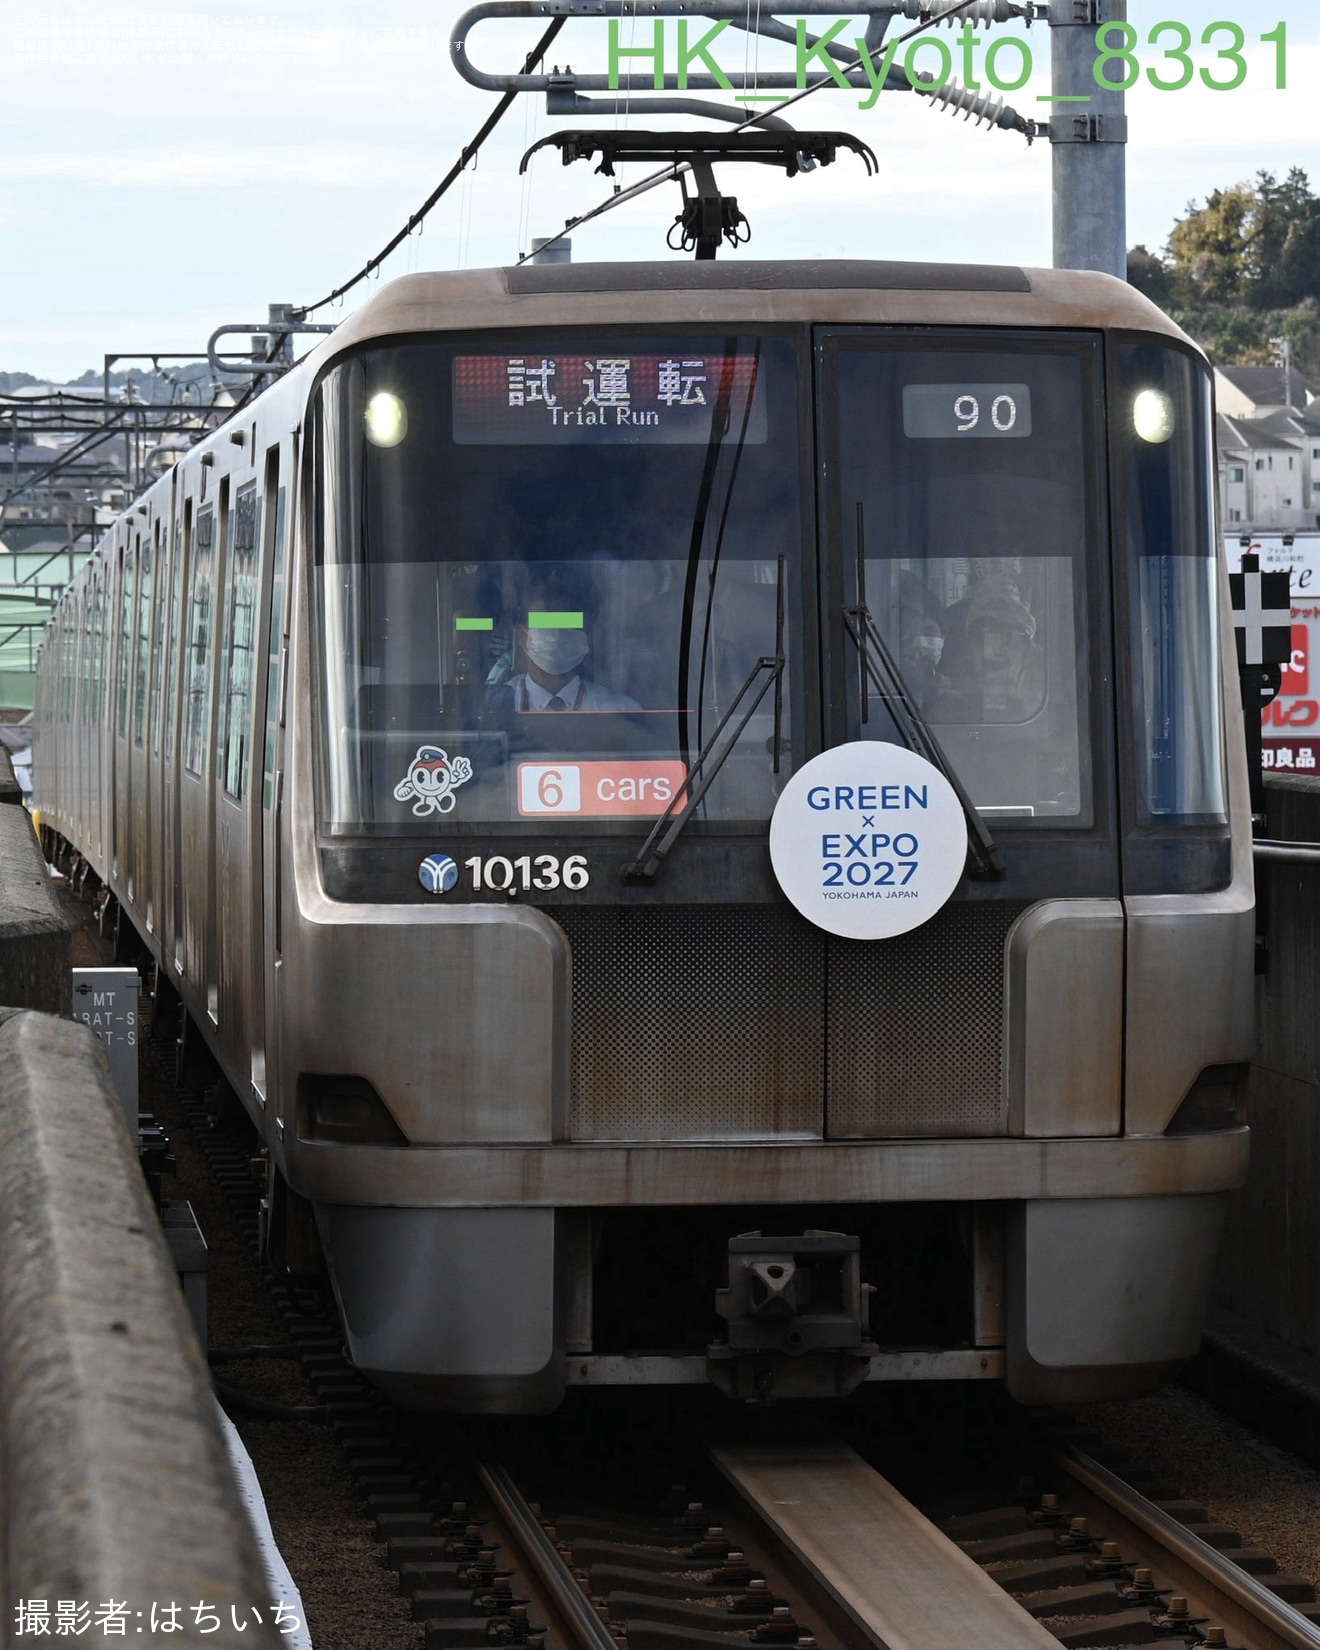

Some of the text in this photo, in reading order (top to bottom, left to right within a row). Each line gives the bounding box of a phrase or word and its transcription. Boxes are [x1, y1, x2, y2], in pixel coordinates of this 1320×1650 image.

[507, 359, 707, 406] 試運転
[546, 406, 659, 425] Trial Run
[953, 394, 1017, 431] 90
[537, 770, 672, 808] 6 cars
[807, 785, 928, 811] GREEN
[822, 833, 919, 858] EXPO
[822, 861, 919, 887] 2027
[822, 890, 919, 900] YOKOHAMA JAPAN
[93, 992, 116, 1006] MT
